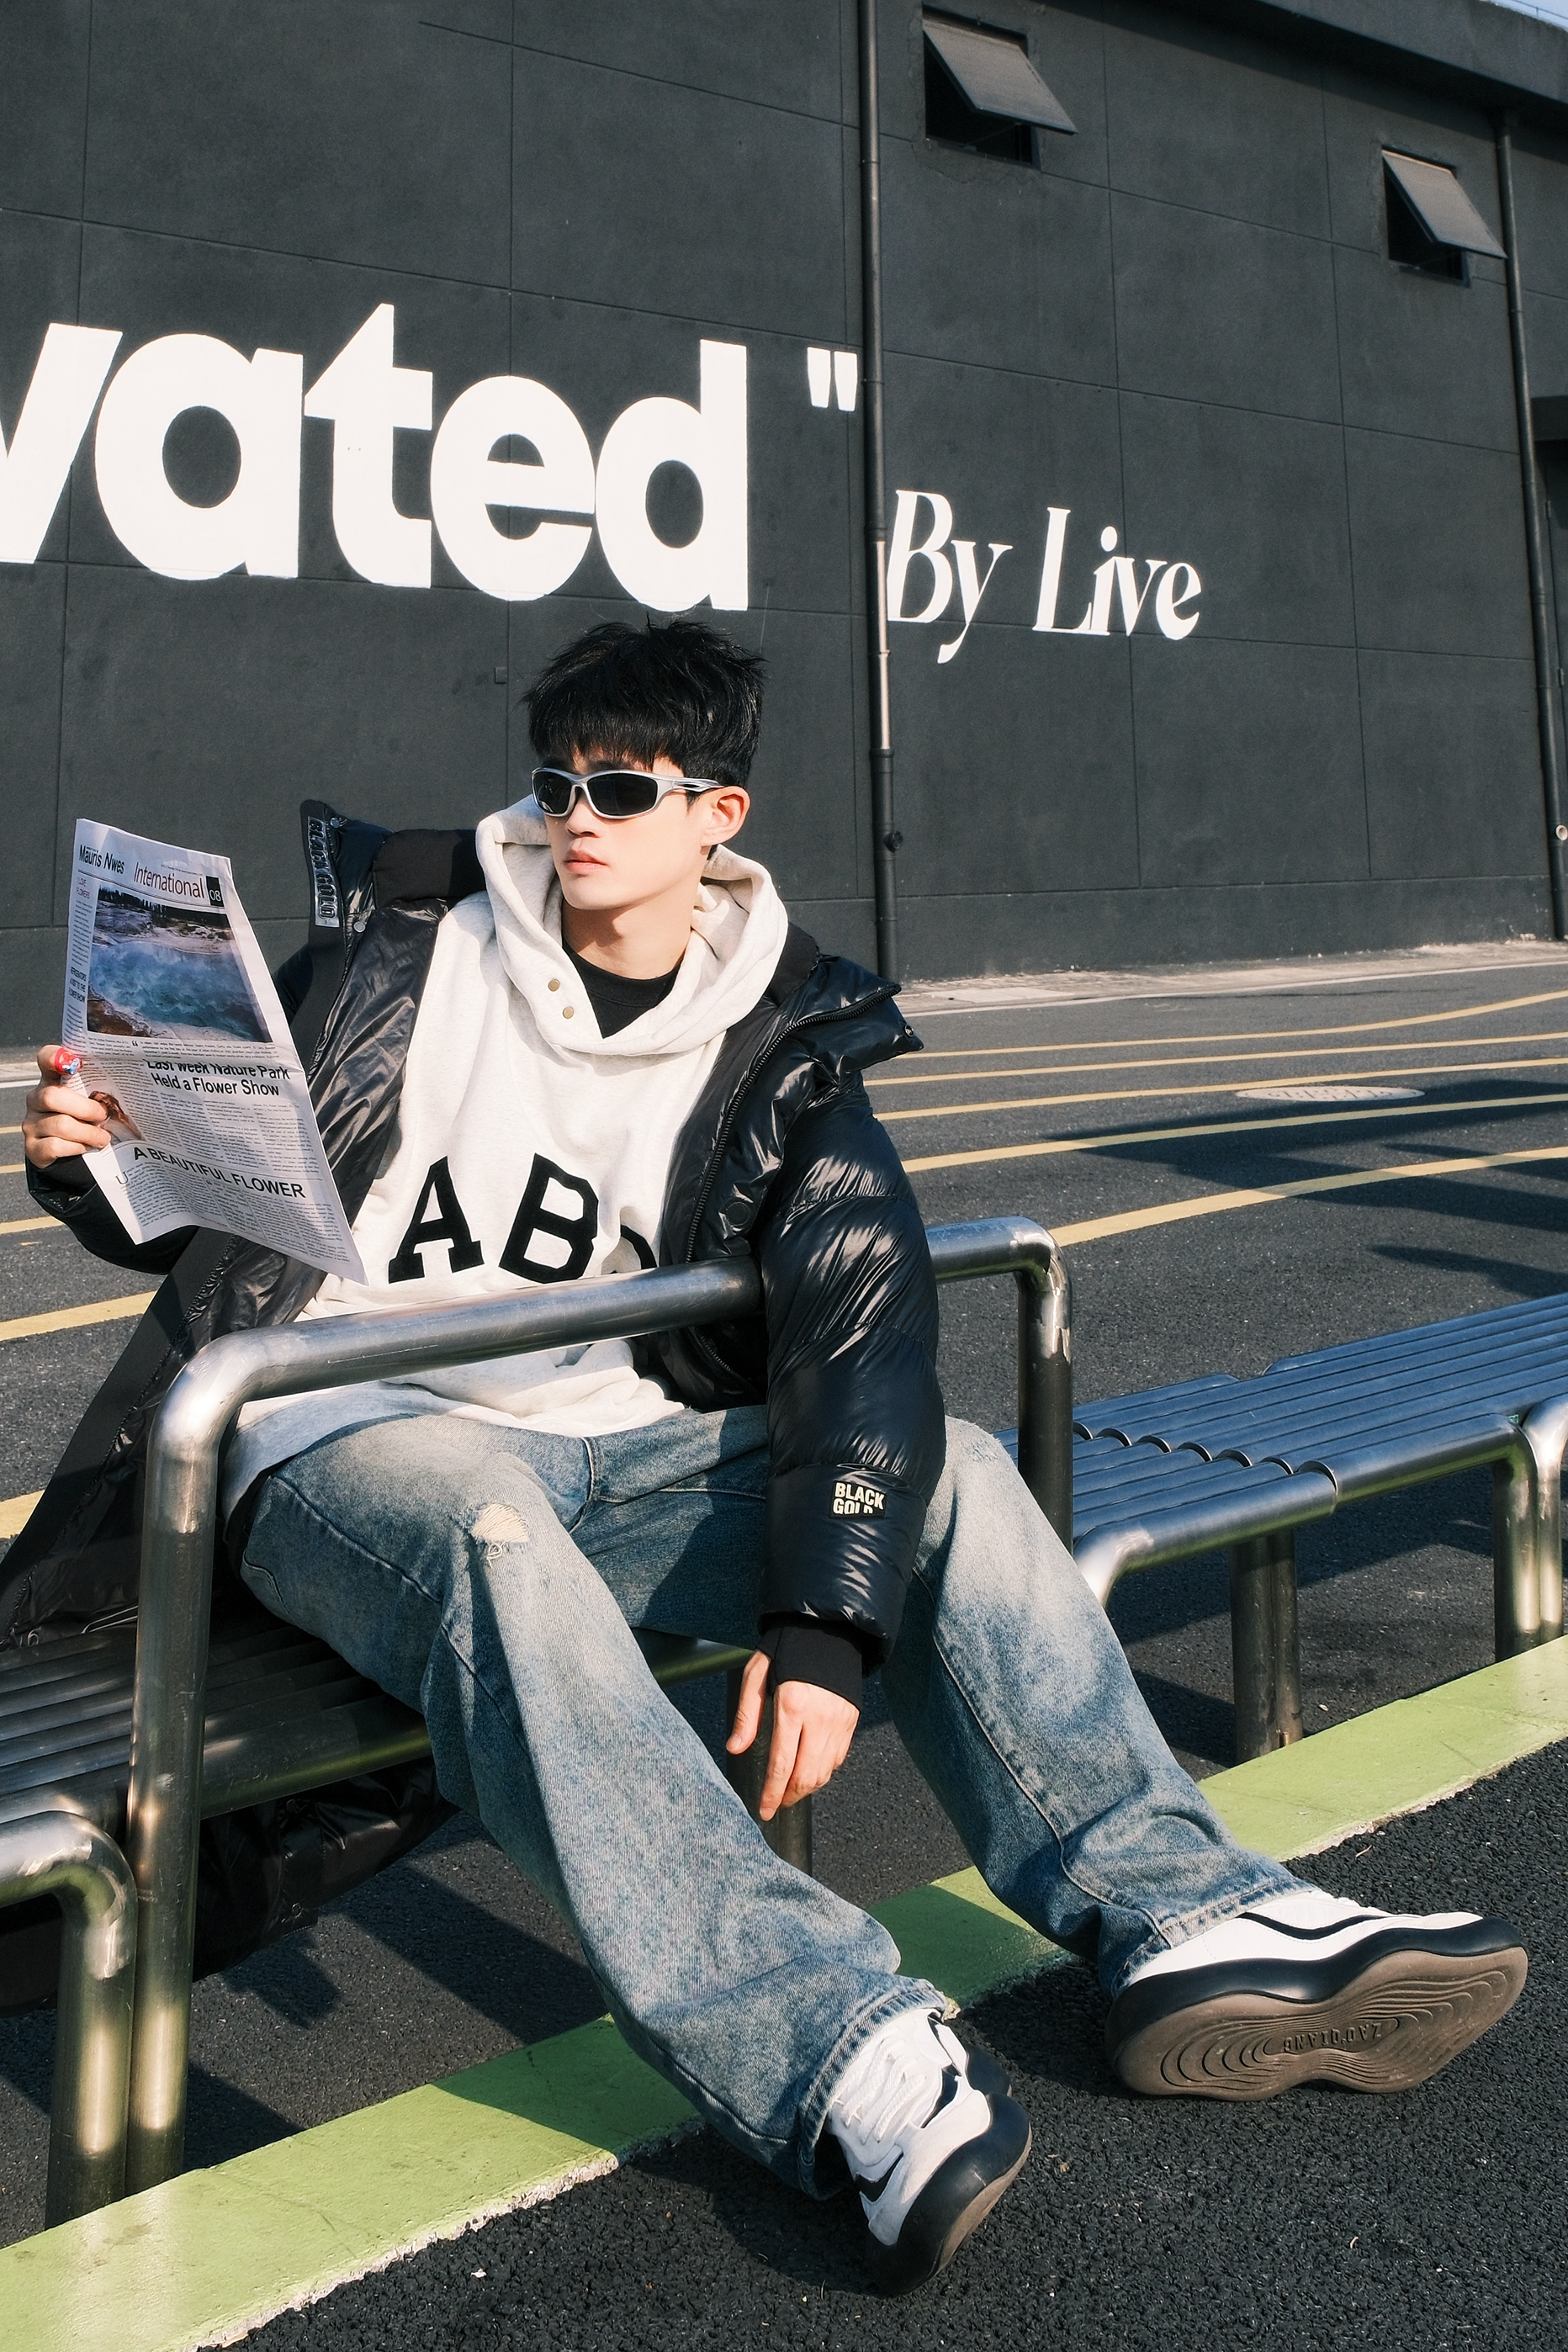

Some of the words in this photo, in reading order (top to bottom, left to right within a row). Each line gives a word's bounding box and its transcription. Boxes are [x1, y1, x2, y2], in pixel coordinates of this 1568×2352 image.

[887, 490, 1013, 663] By
[1032, 507, 1201, 640] Live
[79, 845, 102, 867] Mauris
[103, 852, 125, 874] Nwes
[134, 862, 204, 898] International
[209, 889, 221, 902] 08
[315, 873, 336, 919] GOLD
[151, 1073, 182, 1089] Held
[183, 1079, 192, 1090] a
[193, 1077, 238, 1094] Flower
[241, 1079, 279, 1096] Show
[256, 1065, 291, 1080] Park
[134, 1147, 148, 1161] A
[146, 1147, 231, 1184] BEAUTIFUL
[230, 1173, 306, 1198] FLOWER
[834, 1482, 884, 1510] BLACK
